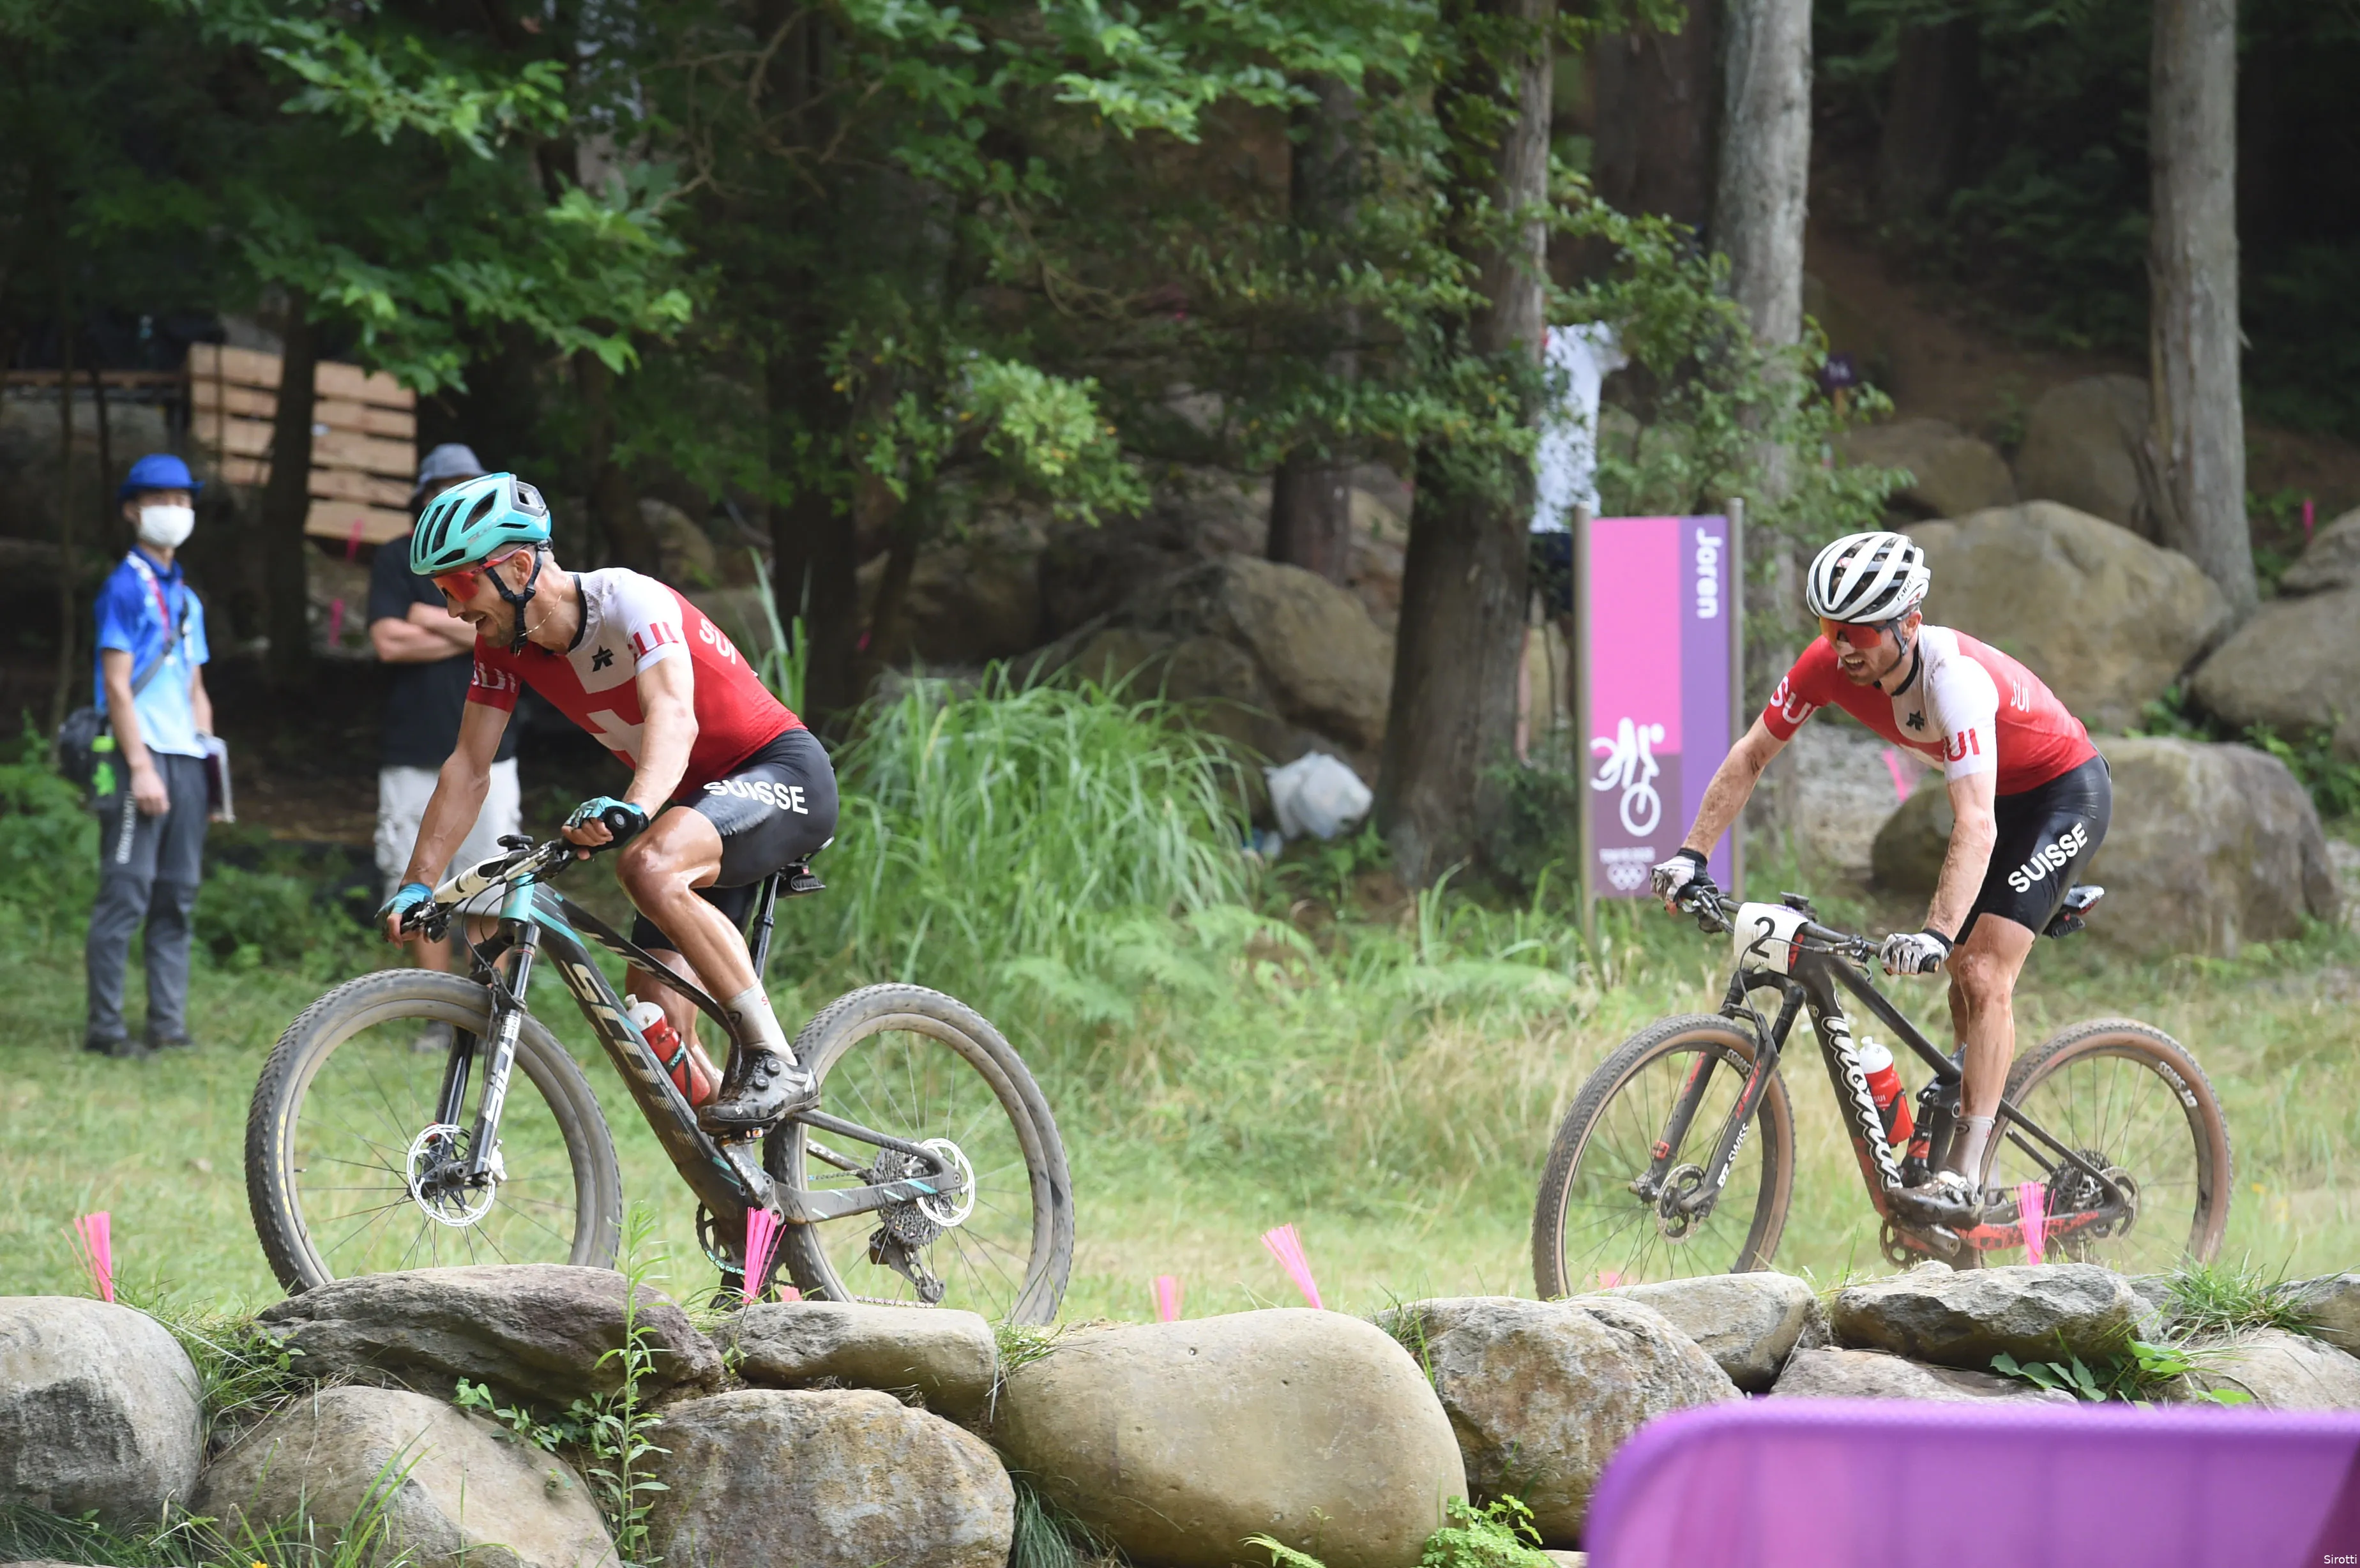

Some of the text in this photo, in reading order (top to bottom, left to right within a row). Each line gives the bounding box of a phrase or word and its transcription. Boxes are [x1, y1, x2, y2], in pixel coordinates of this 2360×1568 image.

[699, 618, 736, 665] SUI
[1770, 675, 1812, 724] SU
[2010, 680, 2029, 713] SUI
[1944, 728, 1980, 762] UI
[703, 780, 808, 815] SUISSE
[2008, 822, 2088, 893] SUISSE
[1750, 916, 1775, 959] 2
[560, 960, 701, 1150] SCOTT
[1728, 1122, 1749, 1161] SWISS
